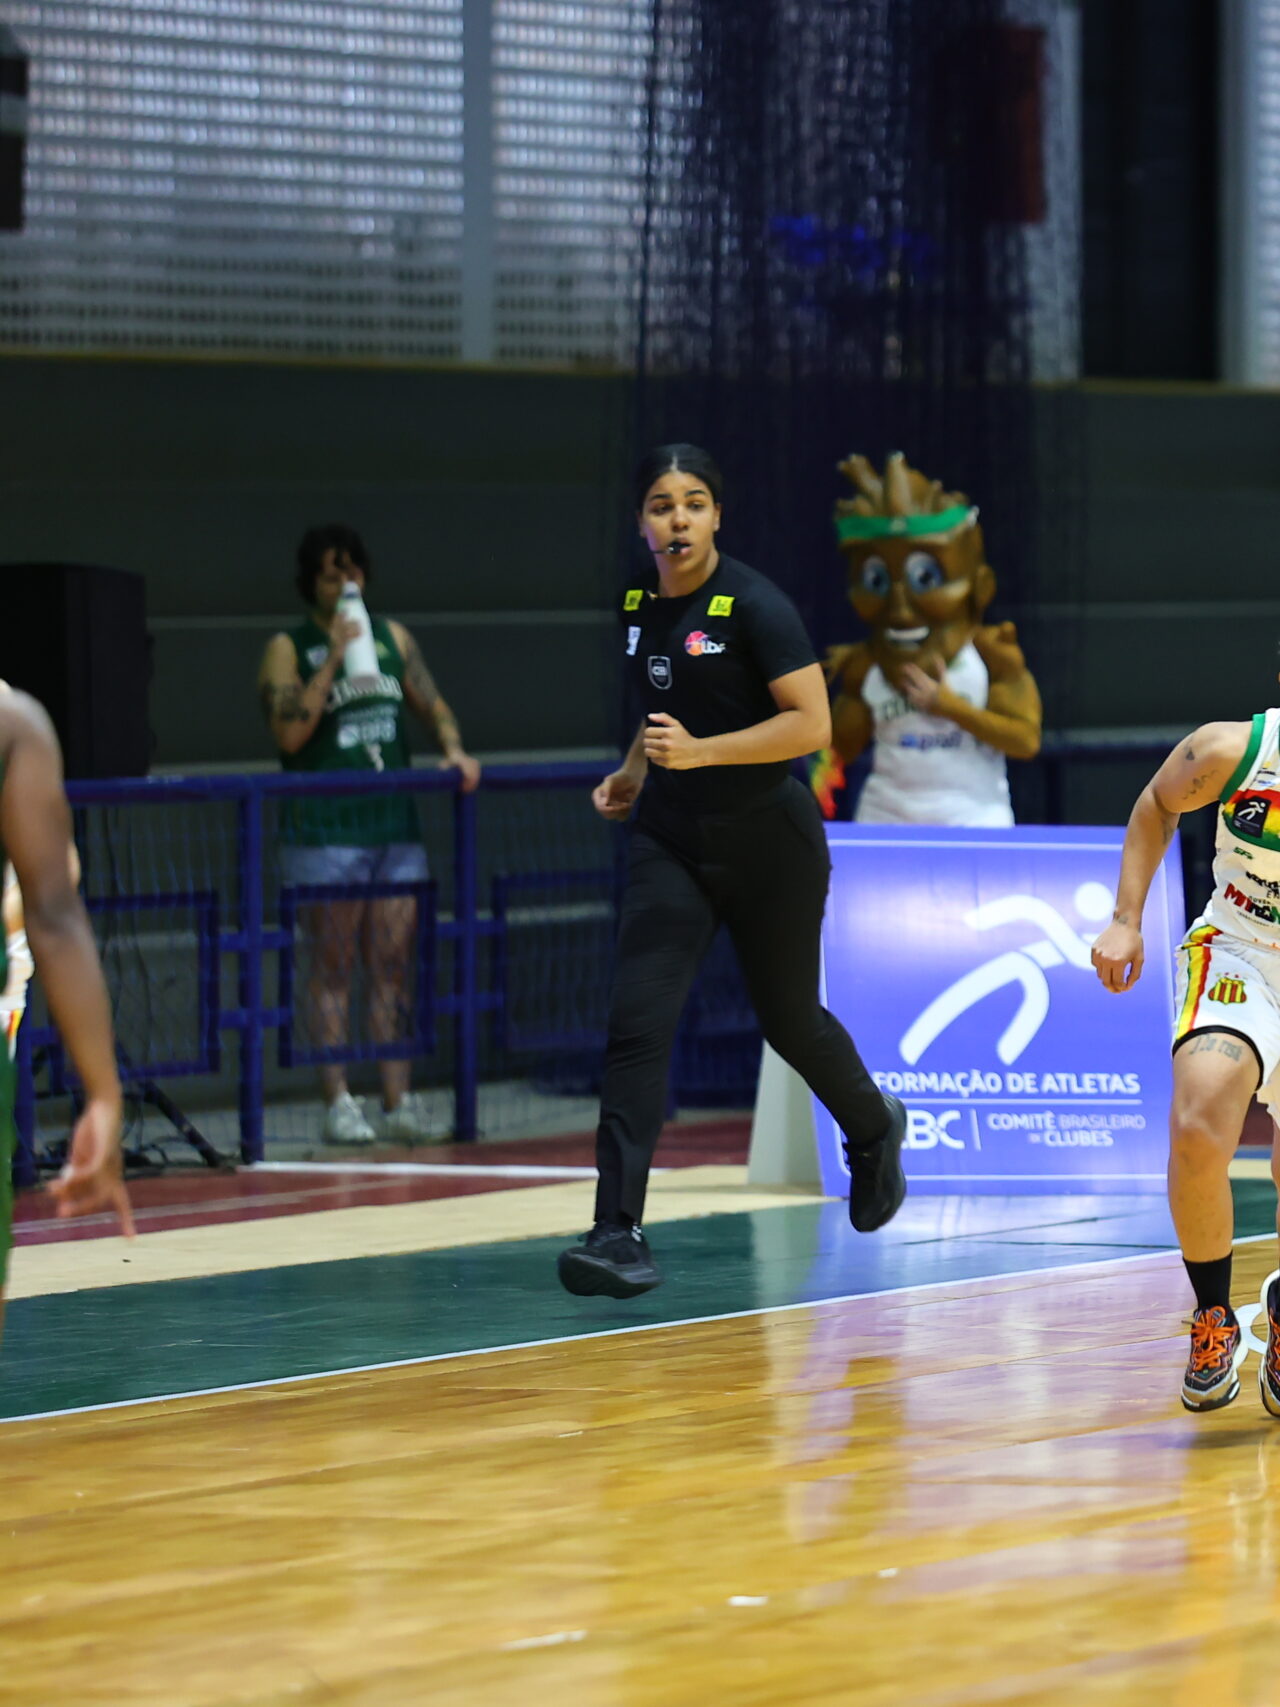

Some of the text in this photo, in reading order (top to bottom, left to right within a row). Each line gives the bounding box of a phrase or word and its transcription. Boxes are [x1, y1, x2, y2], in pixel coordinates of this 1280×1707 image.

[873, 1069, 1141, 1098] FORMAÇÃO DE ATLETAS
[901, 1109, 965, 1150] BC
[987, 1110, 1147, 1130] COMITÊ BRASILEIRO
[1043, 1129, 1114, 1147] CLUBES
